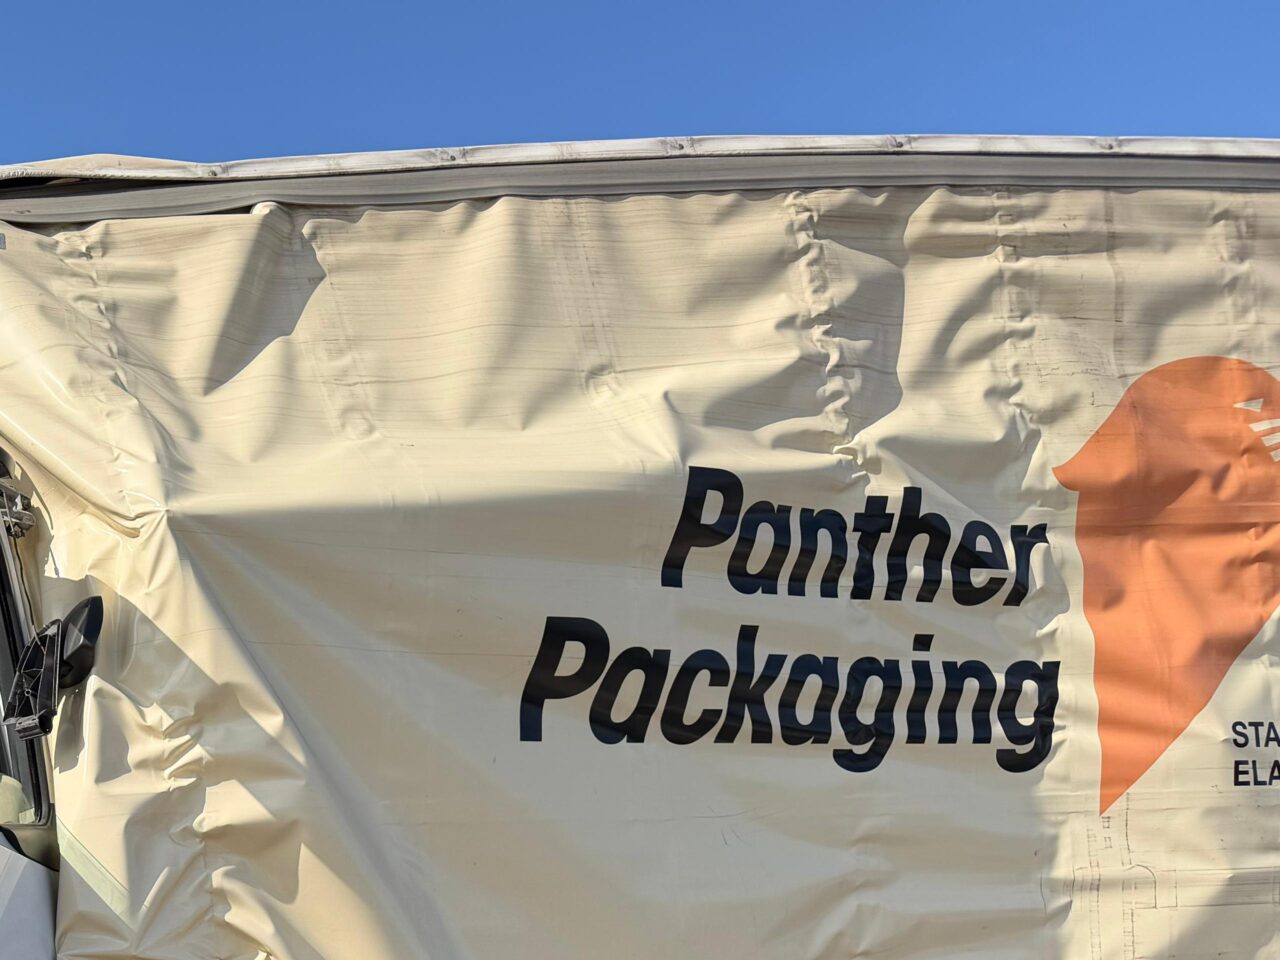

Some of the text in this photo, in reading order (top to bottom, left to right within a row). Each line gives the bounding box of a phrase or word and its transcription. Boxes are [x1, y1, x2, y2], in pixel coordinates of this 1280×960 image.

[660, 465, 1048, 607] Panther
[519, 616, 1061, 773] Packaging
[1231, 720, 1280, 748] STA
[1233, 759, 1280, 787] ELA
